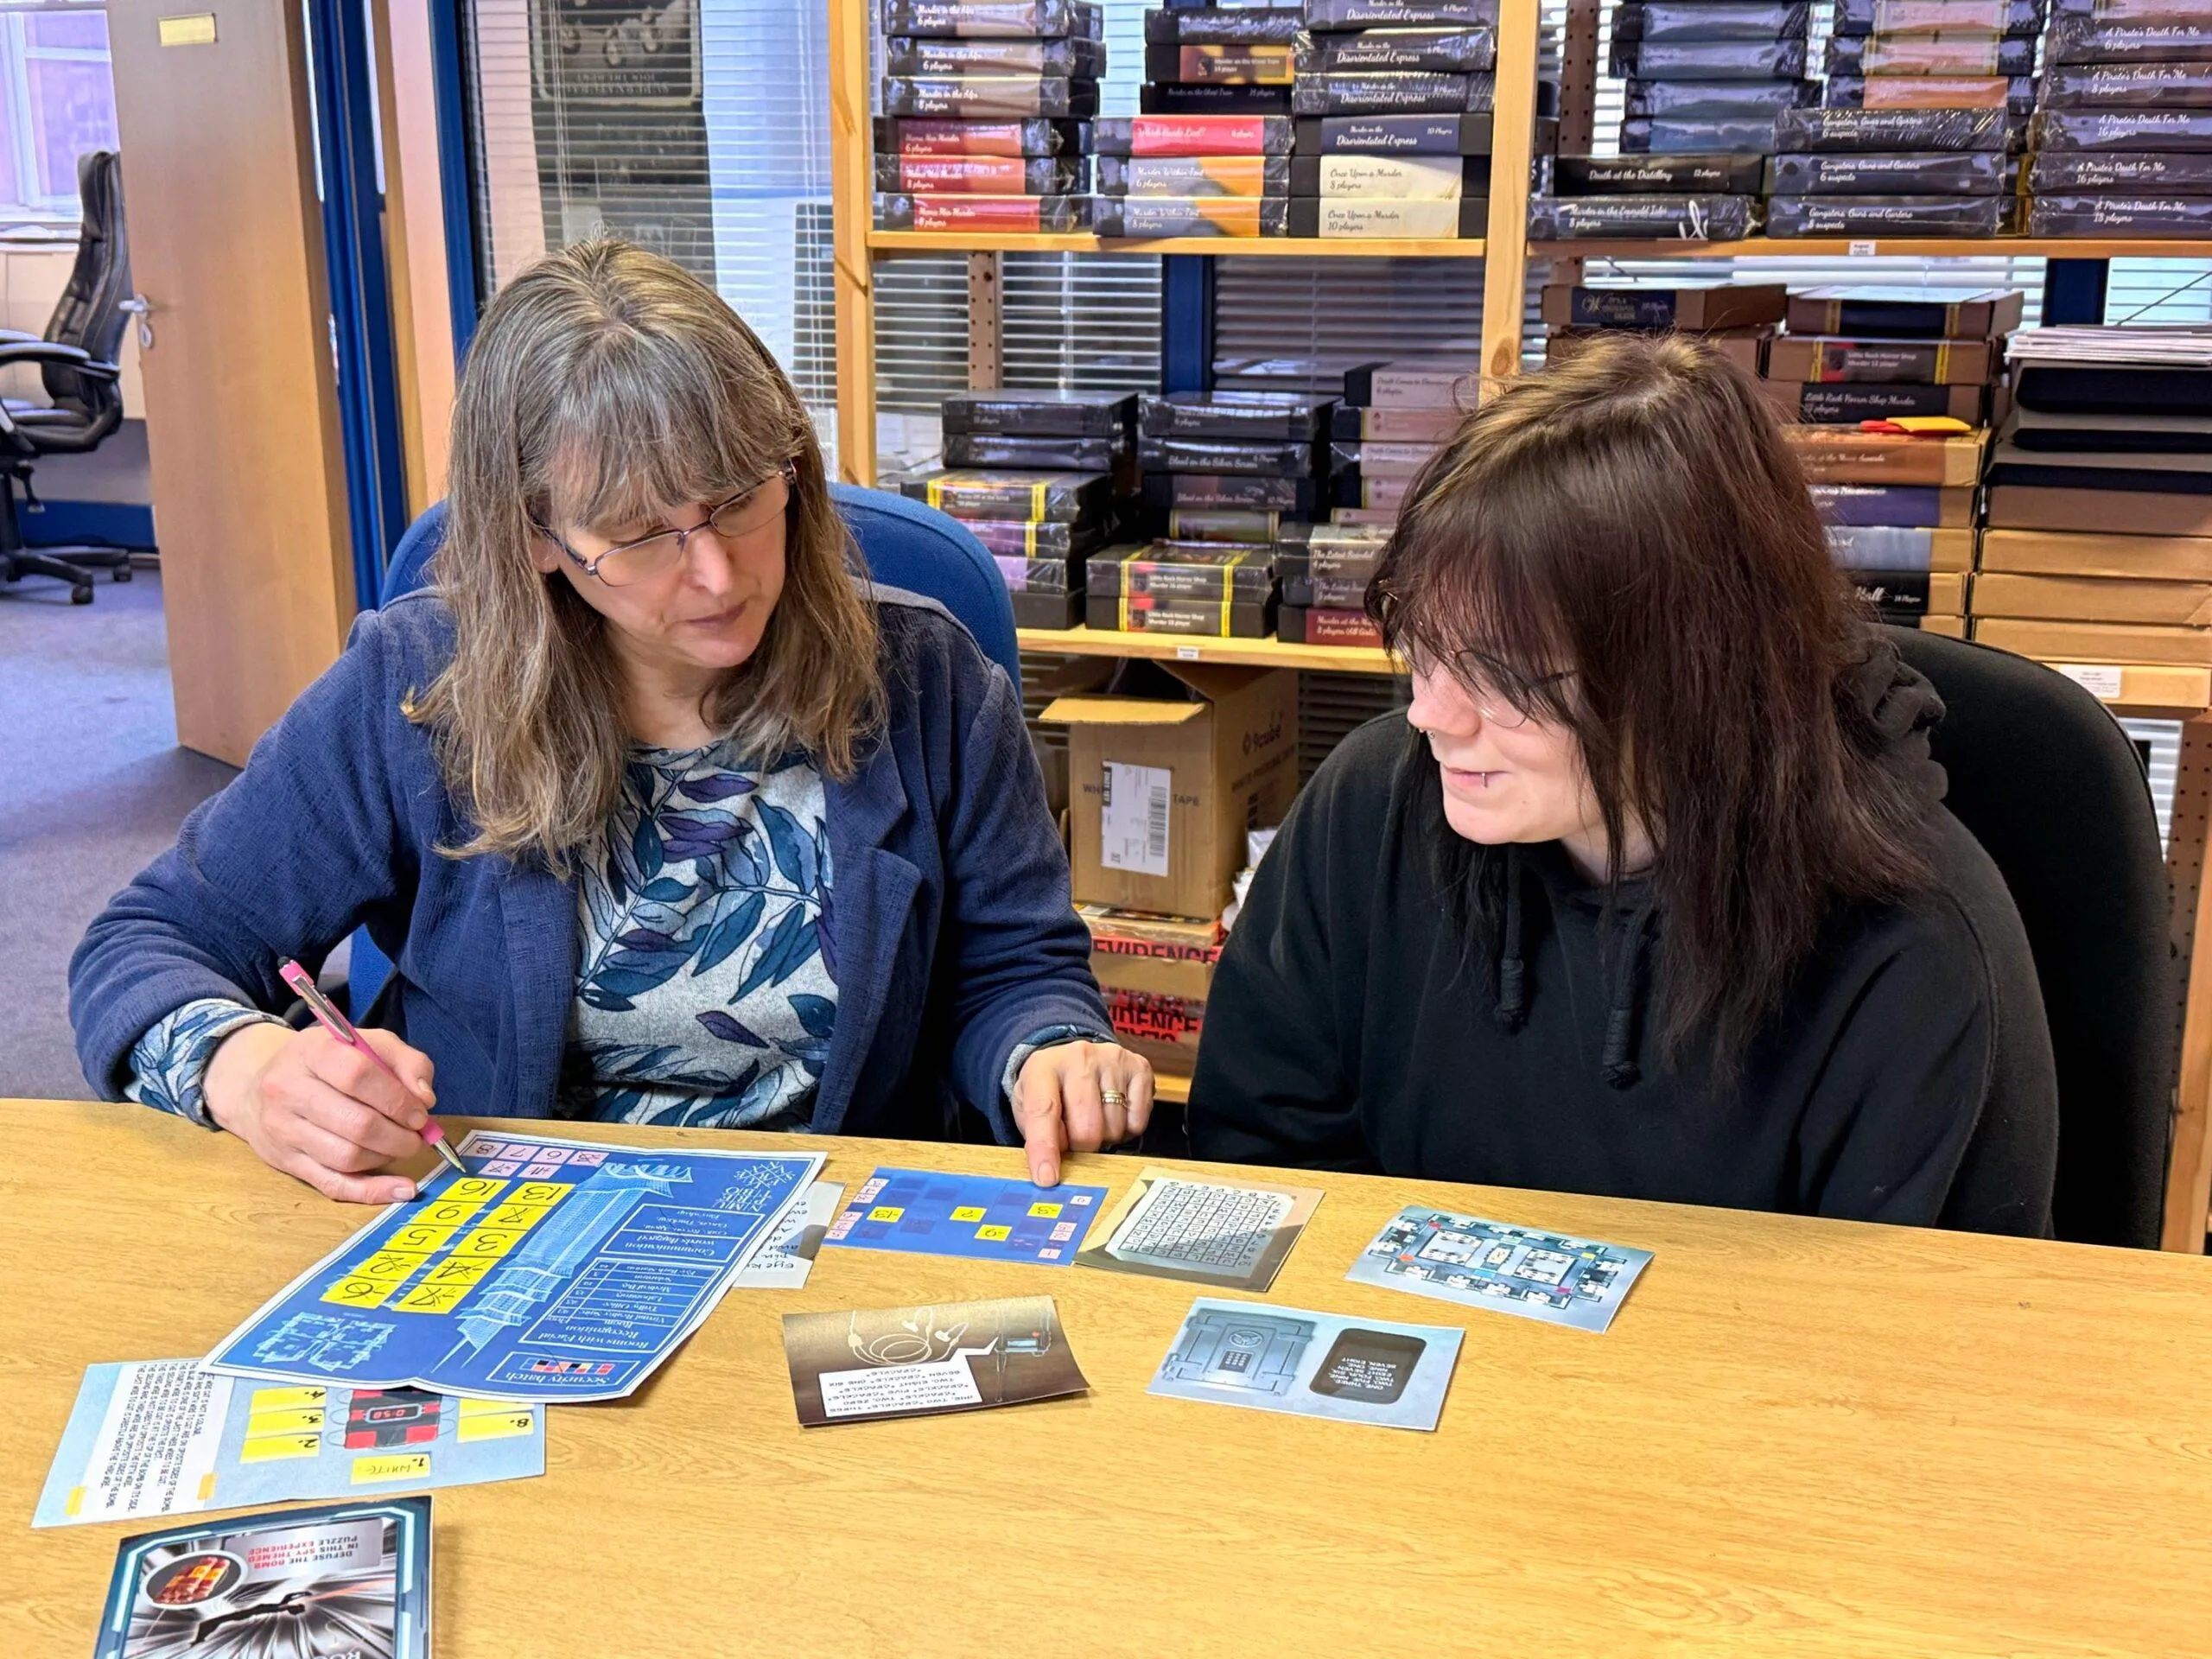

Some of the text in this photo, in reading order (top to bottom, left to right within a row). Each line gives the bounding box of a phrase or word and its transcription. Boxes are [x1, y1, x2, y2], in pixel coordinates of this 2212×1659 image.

[2105, 26, 2200, 37] A Pirate's Death For Me
[2105, 40, 2142, 51] 6 players
[2092, 70, 2187, 81] A Pirate's Death For Me
[2092, 85, 2128, 95] 8 players
[2099, 113, 2190, 125] A Pirate's Death For Me
[2098, 126, 2137, 138] 16 players
[2076, 162, 2165, 173] A Pirate's Death For Me
[1330, 169, 1348, 178] Once
[1349, 169, 1369, 180] Upon
[1376, 168, 1402, 178] Murder
[2076, 175, 2113, 185] 16 players
[1338, 181, 1362, 191] players
[2094, 200, 2186, 211] A Pirate's Death For Me
[1328, 211, 1345, 219] Once
[1347, 210, 1366, 220] Upon
[1375, 210, 1400, 219] Murder
[2094, 213, 2133, 224] 18 players
[1328, 222, 1363, 232] 10 players
[1173, 794, 1199, 807] TAPE
[1094, 939, 1217, 963] EVIDENCE
[509, 1147, 524, 1158] 7
[547, 1151, 563, 1160] 6
[461, 1180, 496, 1197] 16
[523, 1185, 563, 1200] 13
[435, 1203, 460, 1219] 9
[407, 1228, 437, 1245] 5
[474, 1232, 508, 1252] 3
[625, 1243, 715, 1256] Communication
[565, 1325, 639, 1339] Recognition
[537, 1332, 649, 1348] Rooms with Facial
[548, 1375, 609, 1384] Security
[304, 1390, 326, 1399] 4.
[302, 1414, 321, 1424] 3.
[510, 1418, 529, 1428] 8.
[298, 1438, 319, 1448] 2.
[366, 1464, 410, 1476] WHITE
[248, 1535, 358, 1554] PUZZLE EXPERIENCE
[319, 1544, 343, 1553] THIS
[248, 1551, 290, 1562] THEMED
[296, 1548, 315, 1556] SPY
[312, 1550, 353, 1560] DEFUSE
[253, 1560, 285, 1569] BOMB
